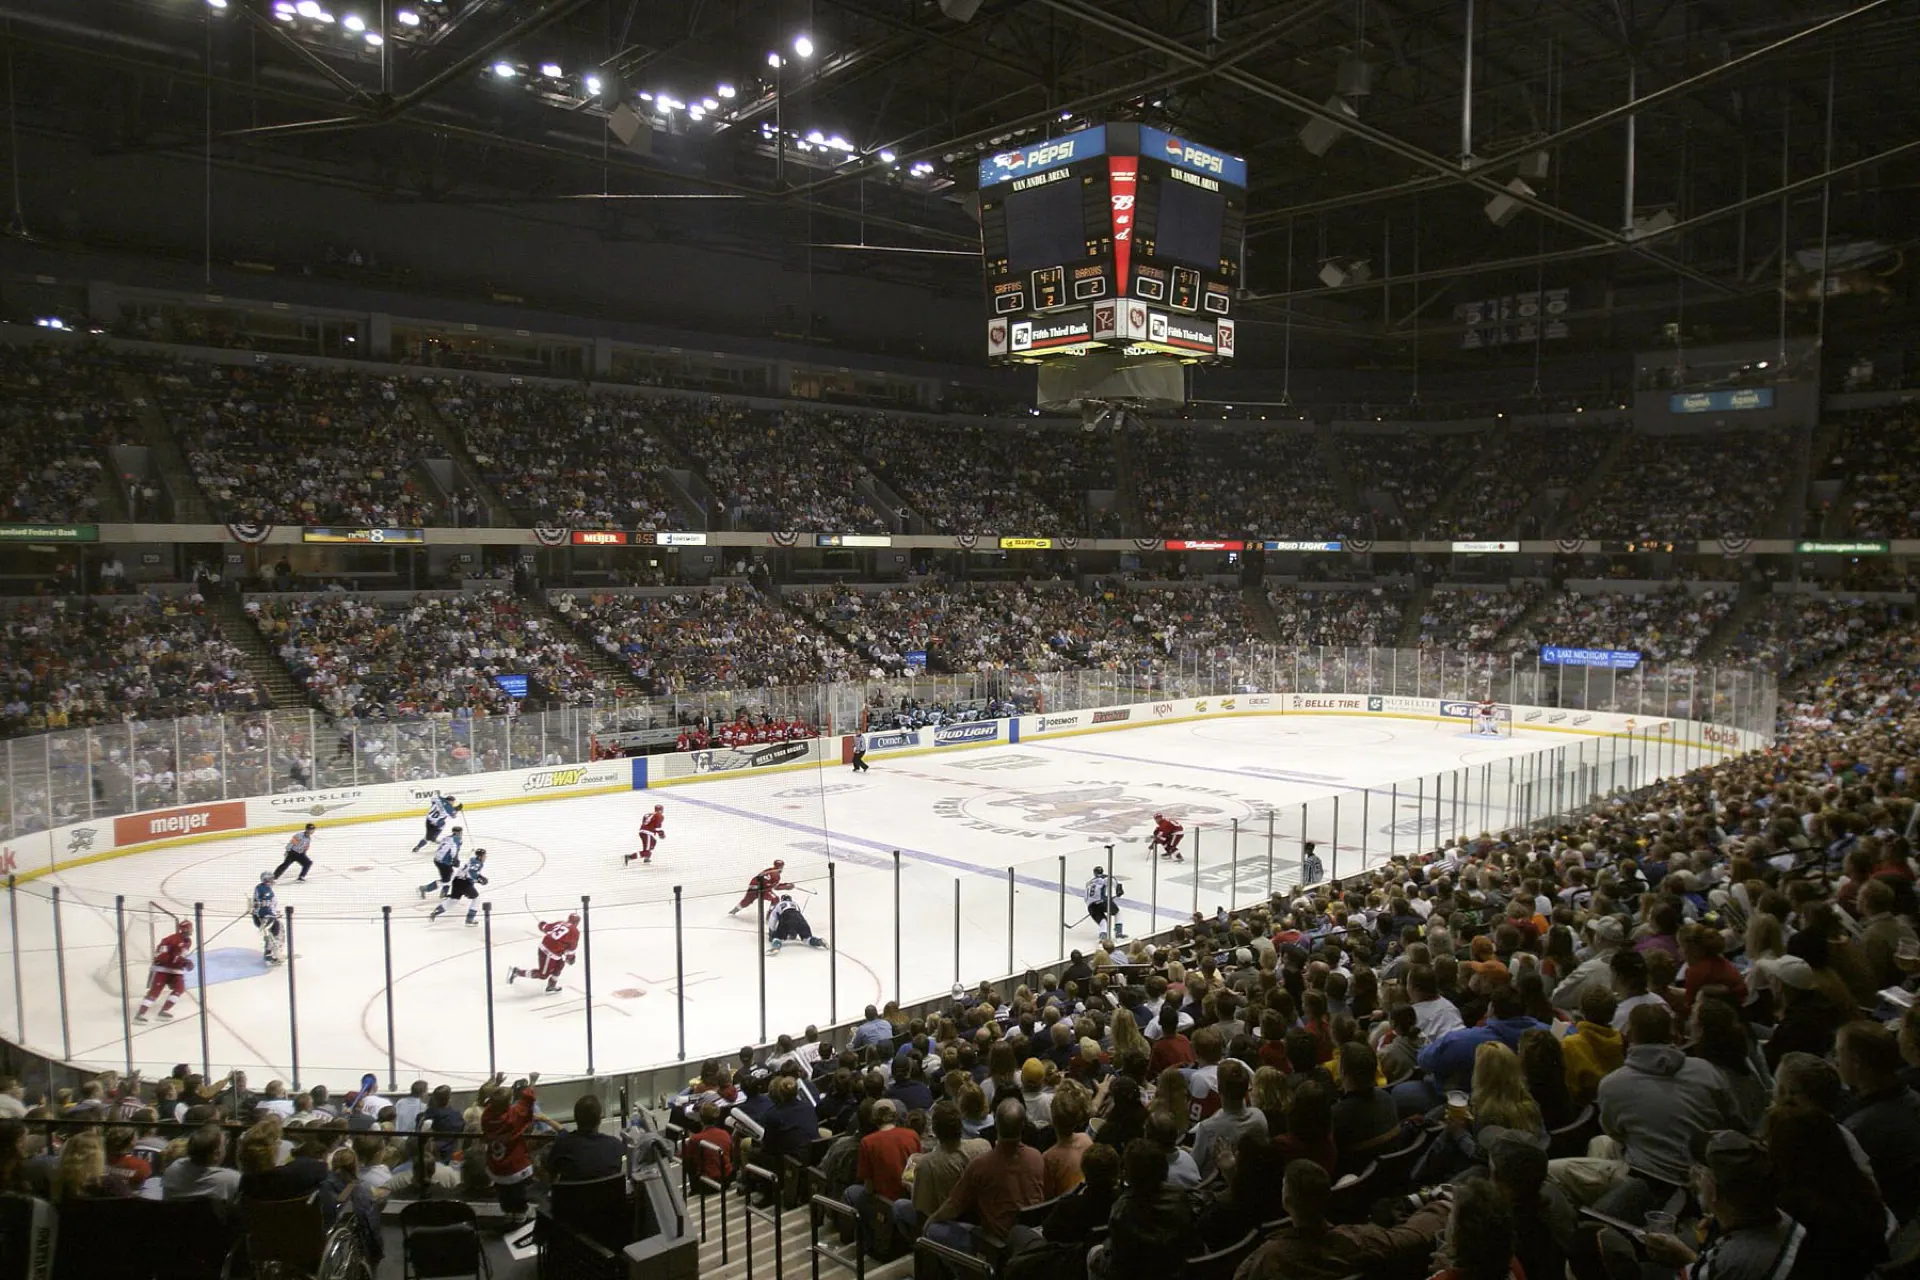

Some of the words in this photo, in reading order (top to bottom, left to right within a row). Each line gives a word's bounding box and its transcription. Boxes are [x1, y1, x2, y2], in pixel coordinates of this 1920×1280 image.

[1027, 140, 1075, 169] PEPSI
[1184, 146, 1224, 174] PEPSI
[1012, 179, 1026, 191] VAN
[1026, 174, 1047, 188] ANDEL
[1047, 168, 1070, 184] ARENA
[1171, 168, 1183, 180] VAN
[1183, 172, 1201, 187] ANDEL
[1201, 177, 1219, 192] ARENA
[1075, 265, 1102, 279] BARONS
[1090, 281, 1098, 293] 2
[1150, 283, 1157, 295] 2
[1010, 296, 1017, 307] 2
[1046, 295, 1054, 305] 2
[1181, 295, 1189, 307] 2
[1032, 329, 1049, 341] Fifth
[1049, 326, 1069, 338] Third
[1069, 323, 1089, 335] Bank
[1167, 326, 1183, 338] Fifth
[1182, 329, 1199, 341] Third
[1198, 333, 1214, 344] Bank
[58, 528, 77, 537] Bank
[371, 529, 385, 543] 8
[1277, 542, 1297, 551] BUD
[1153, 703, 1174, 718] IKON
[1305, 699, 1334, 709] BELLE
[1338, 700, 1361, 710] TIRE
[1046, 716, 1078, 727] FOREMOST
[939, 729, 963, 741] BUD
[963, 726, 997, 739] LIGHT
[1704, 727, 1740, 747] Kodak
[523, 766, 587, 792] SUBWAY
[271, 790, 362, 806] CHRYSLER
[150, 812, 210, 836] meijer
